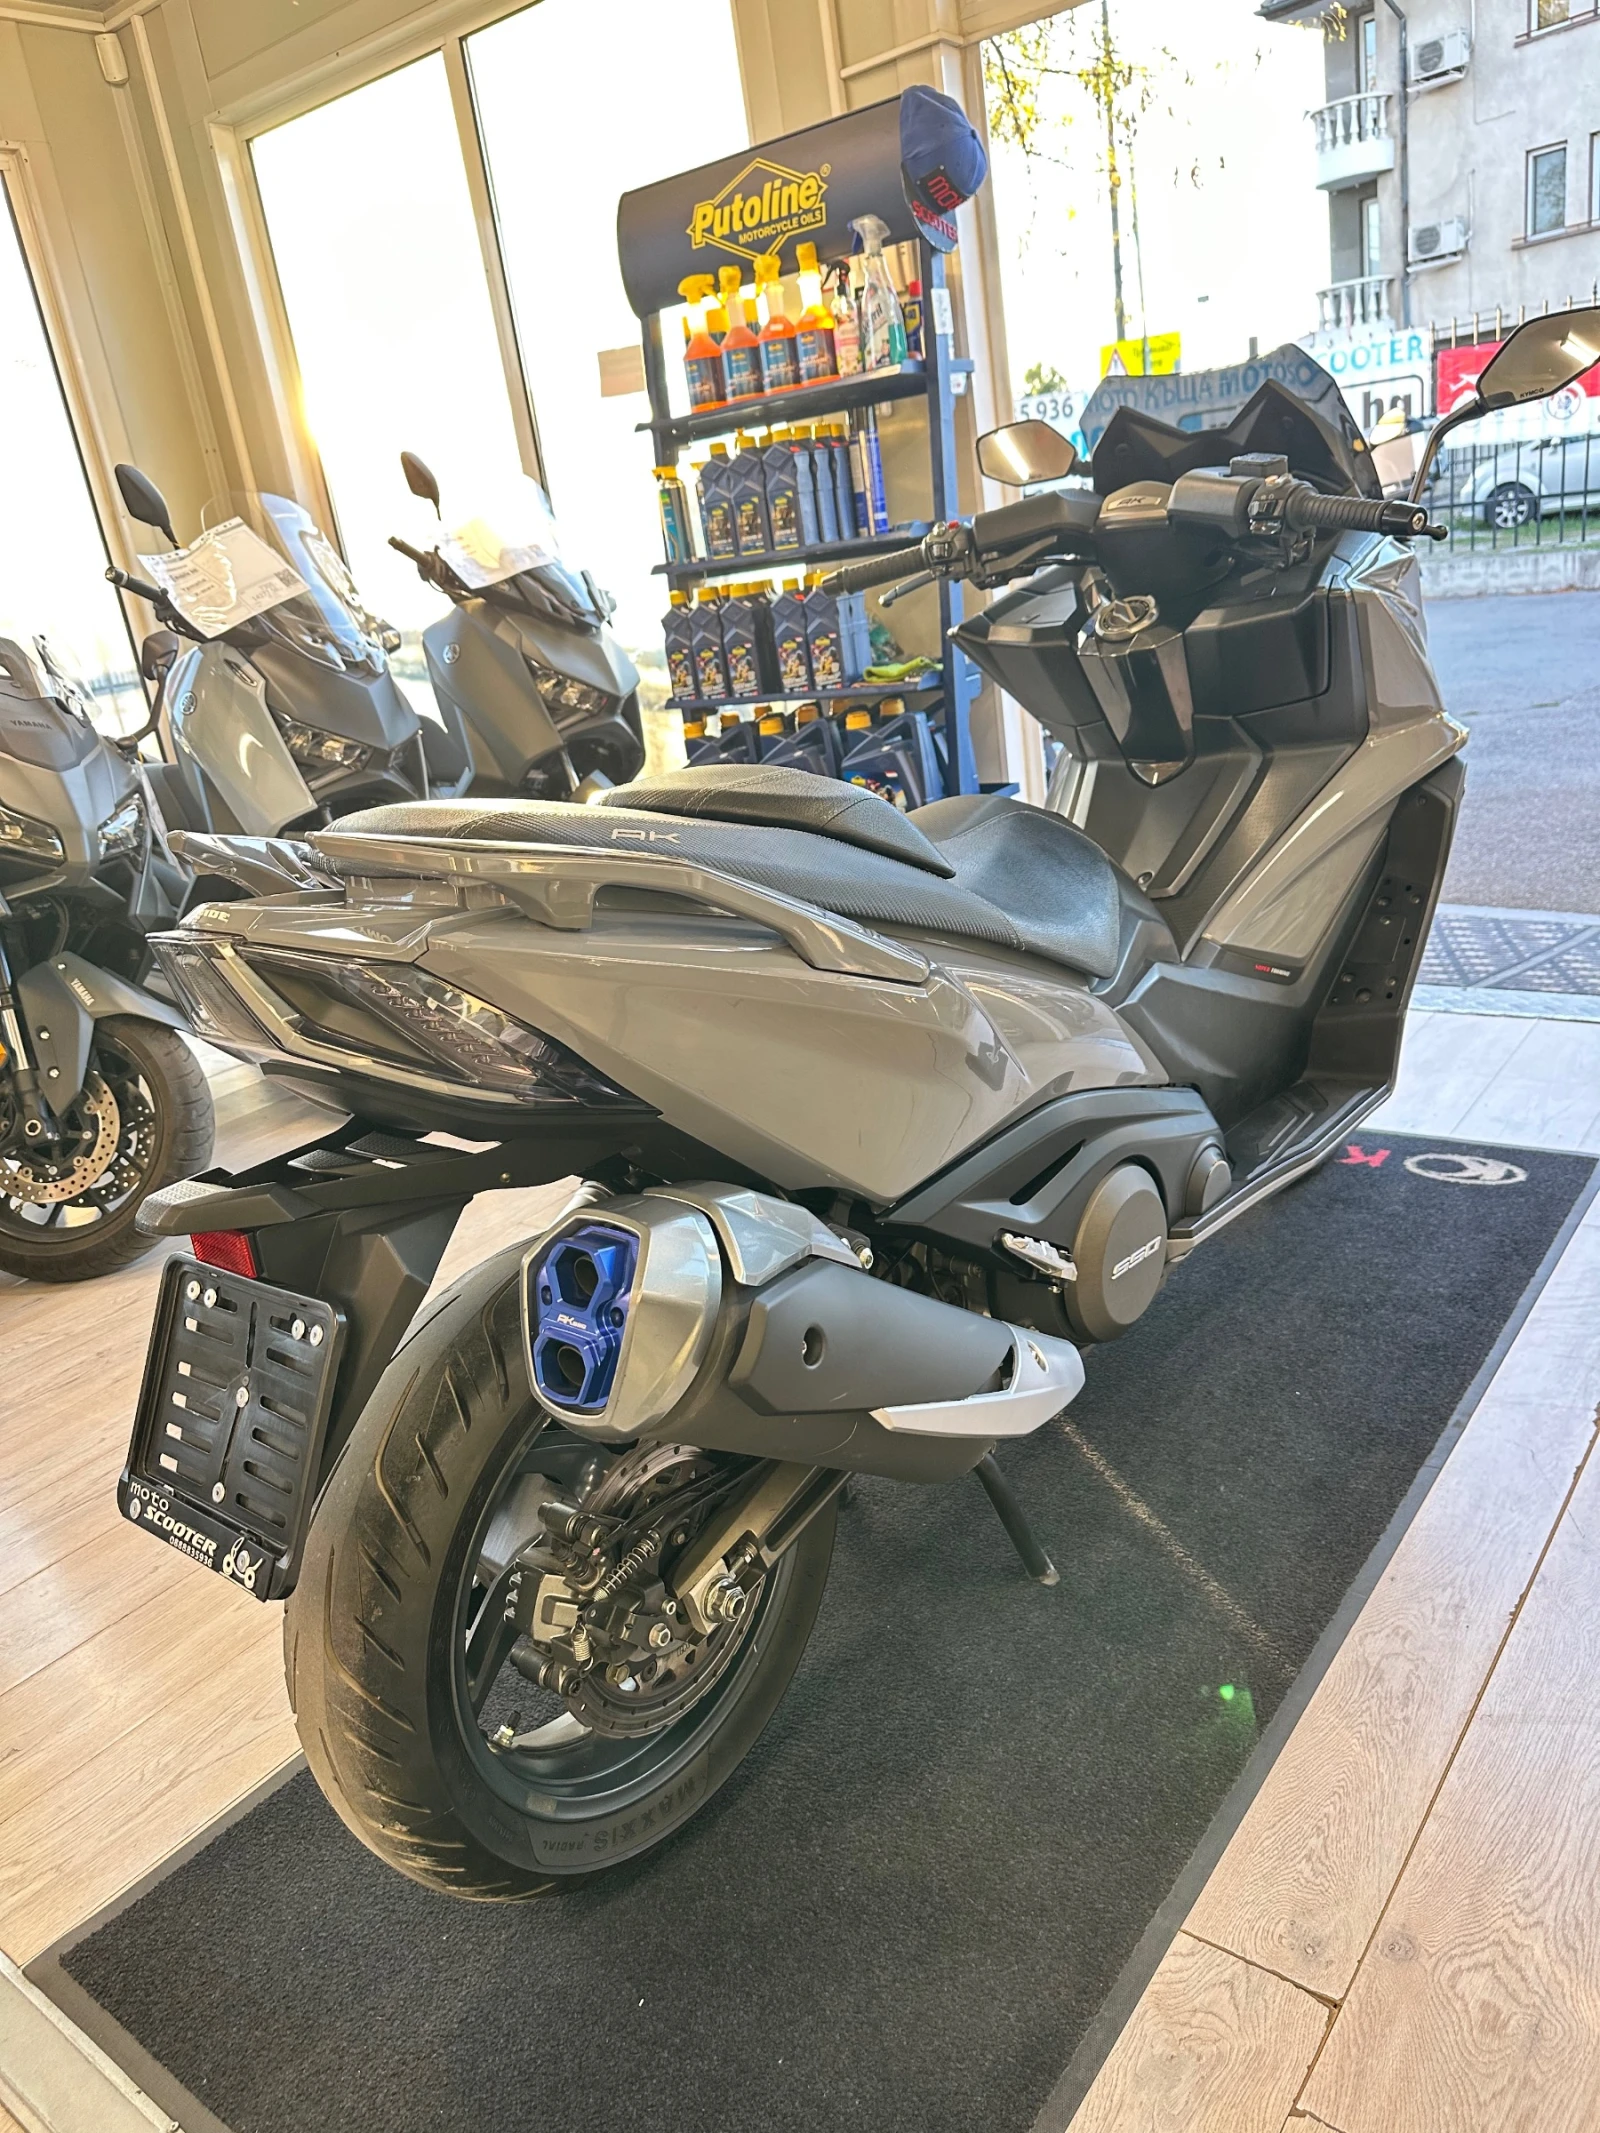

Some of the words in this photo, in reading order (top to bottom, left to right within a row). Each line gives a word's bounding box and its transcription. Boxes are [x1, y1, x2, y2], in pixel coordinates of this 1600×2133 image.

[695, 176, 819, 245] Putoline
[738, 215, 799, 245] MOTORCYCLE
[800, 209, 822, 226] OILS
[1520, 387, 1545, 399] KYMCO
[9, 719, 53, 731] YAMAHA
[70, 977, 95, 1006] YAMAHA
[130, 1481, 169, 1512] moto
[143, 1505, 218, 1557] SCOOTER
[169, 1535, 214, 1568] 0888835936
[593, 1776, 697, 1852] MAXXIS
[542, 1839, 585, 1851] RADIAL
